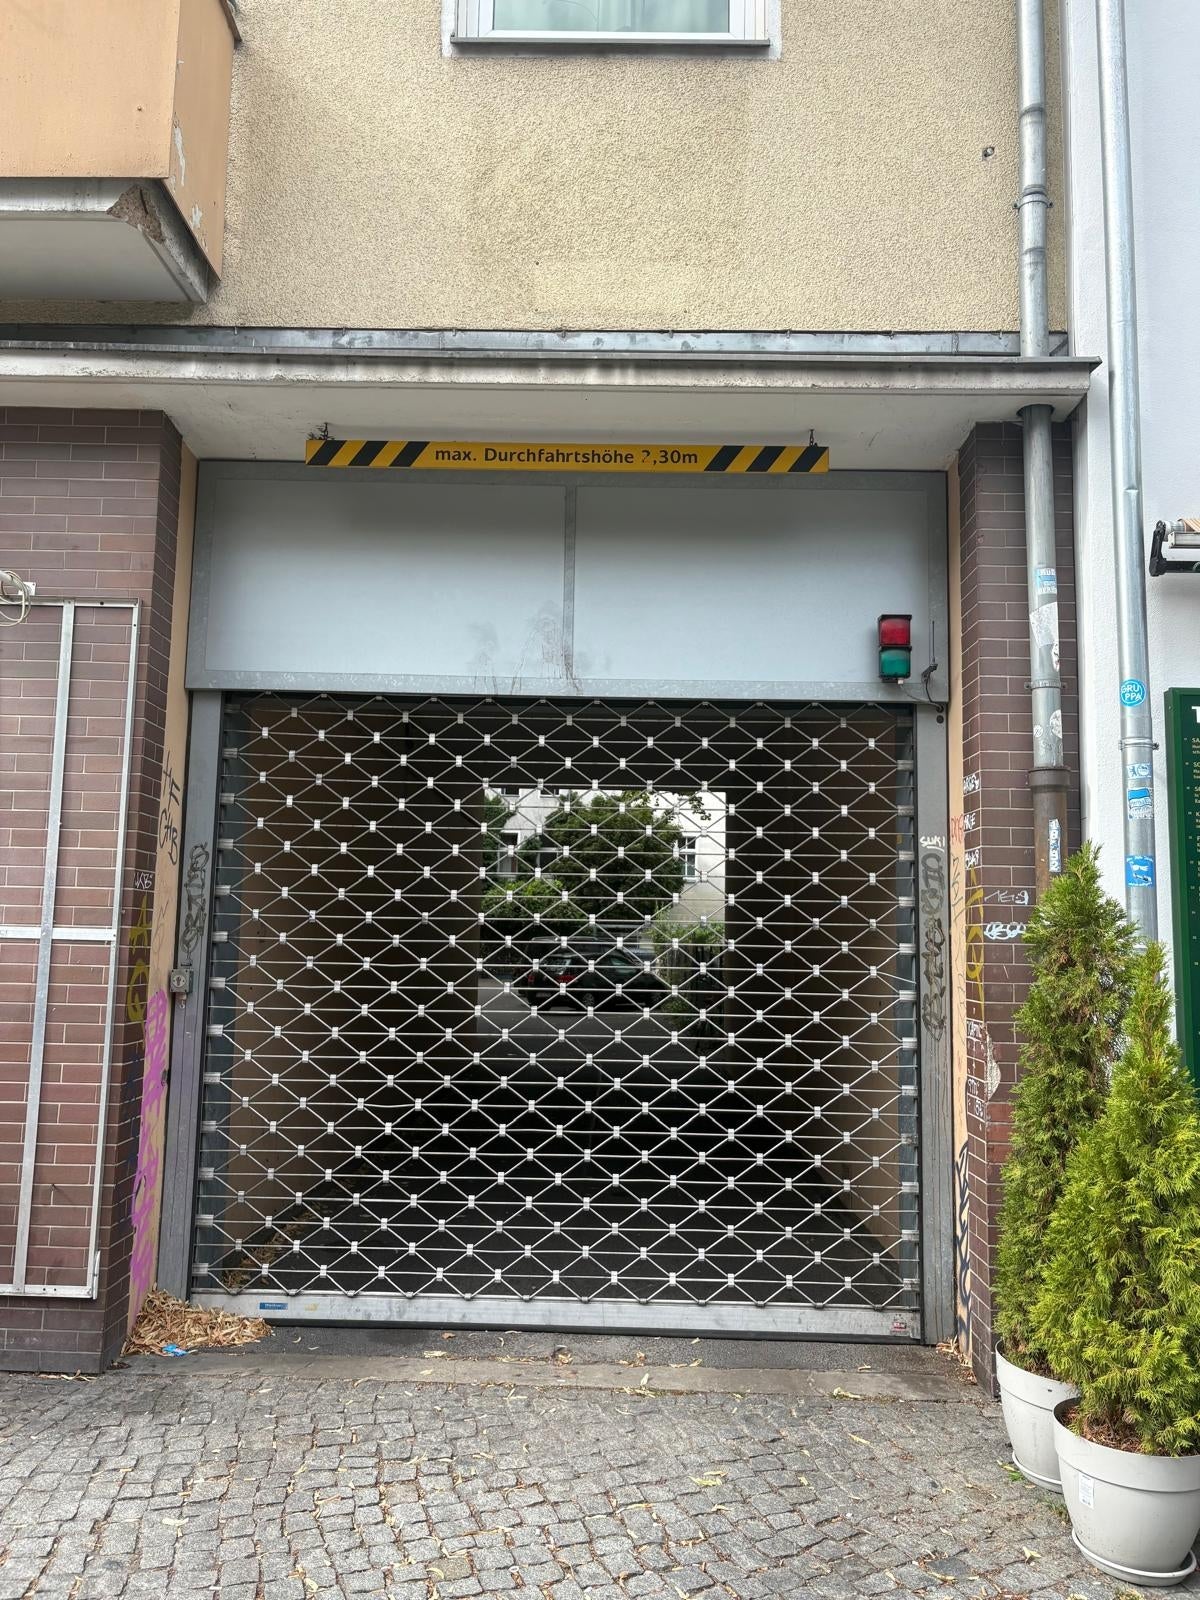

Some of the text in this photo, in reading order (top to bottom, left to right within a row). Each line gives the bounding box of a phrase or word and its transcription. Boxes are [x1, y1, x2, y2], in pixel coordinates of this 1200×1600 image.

[435, 449, 477, 462] max.
[484, 447, 634, 464] Durchfahrtshöhe
[1121, 684, 1141, 693] GRU
[1124, 692, 1142, 701] PPA
